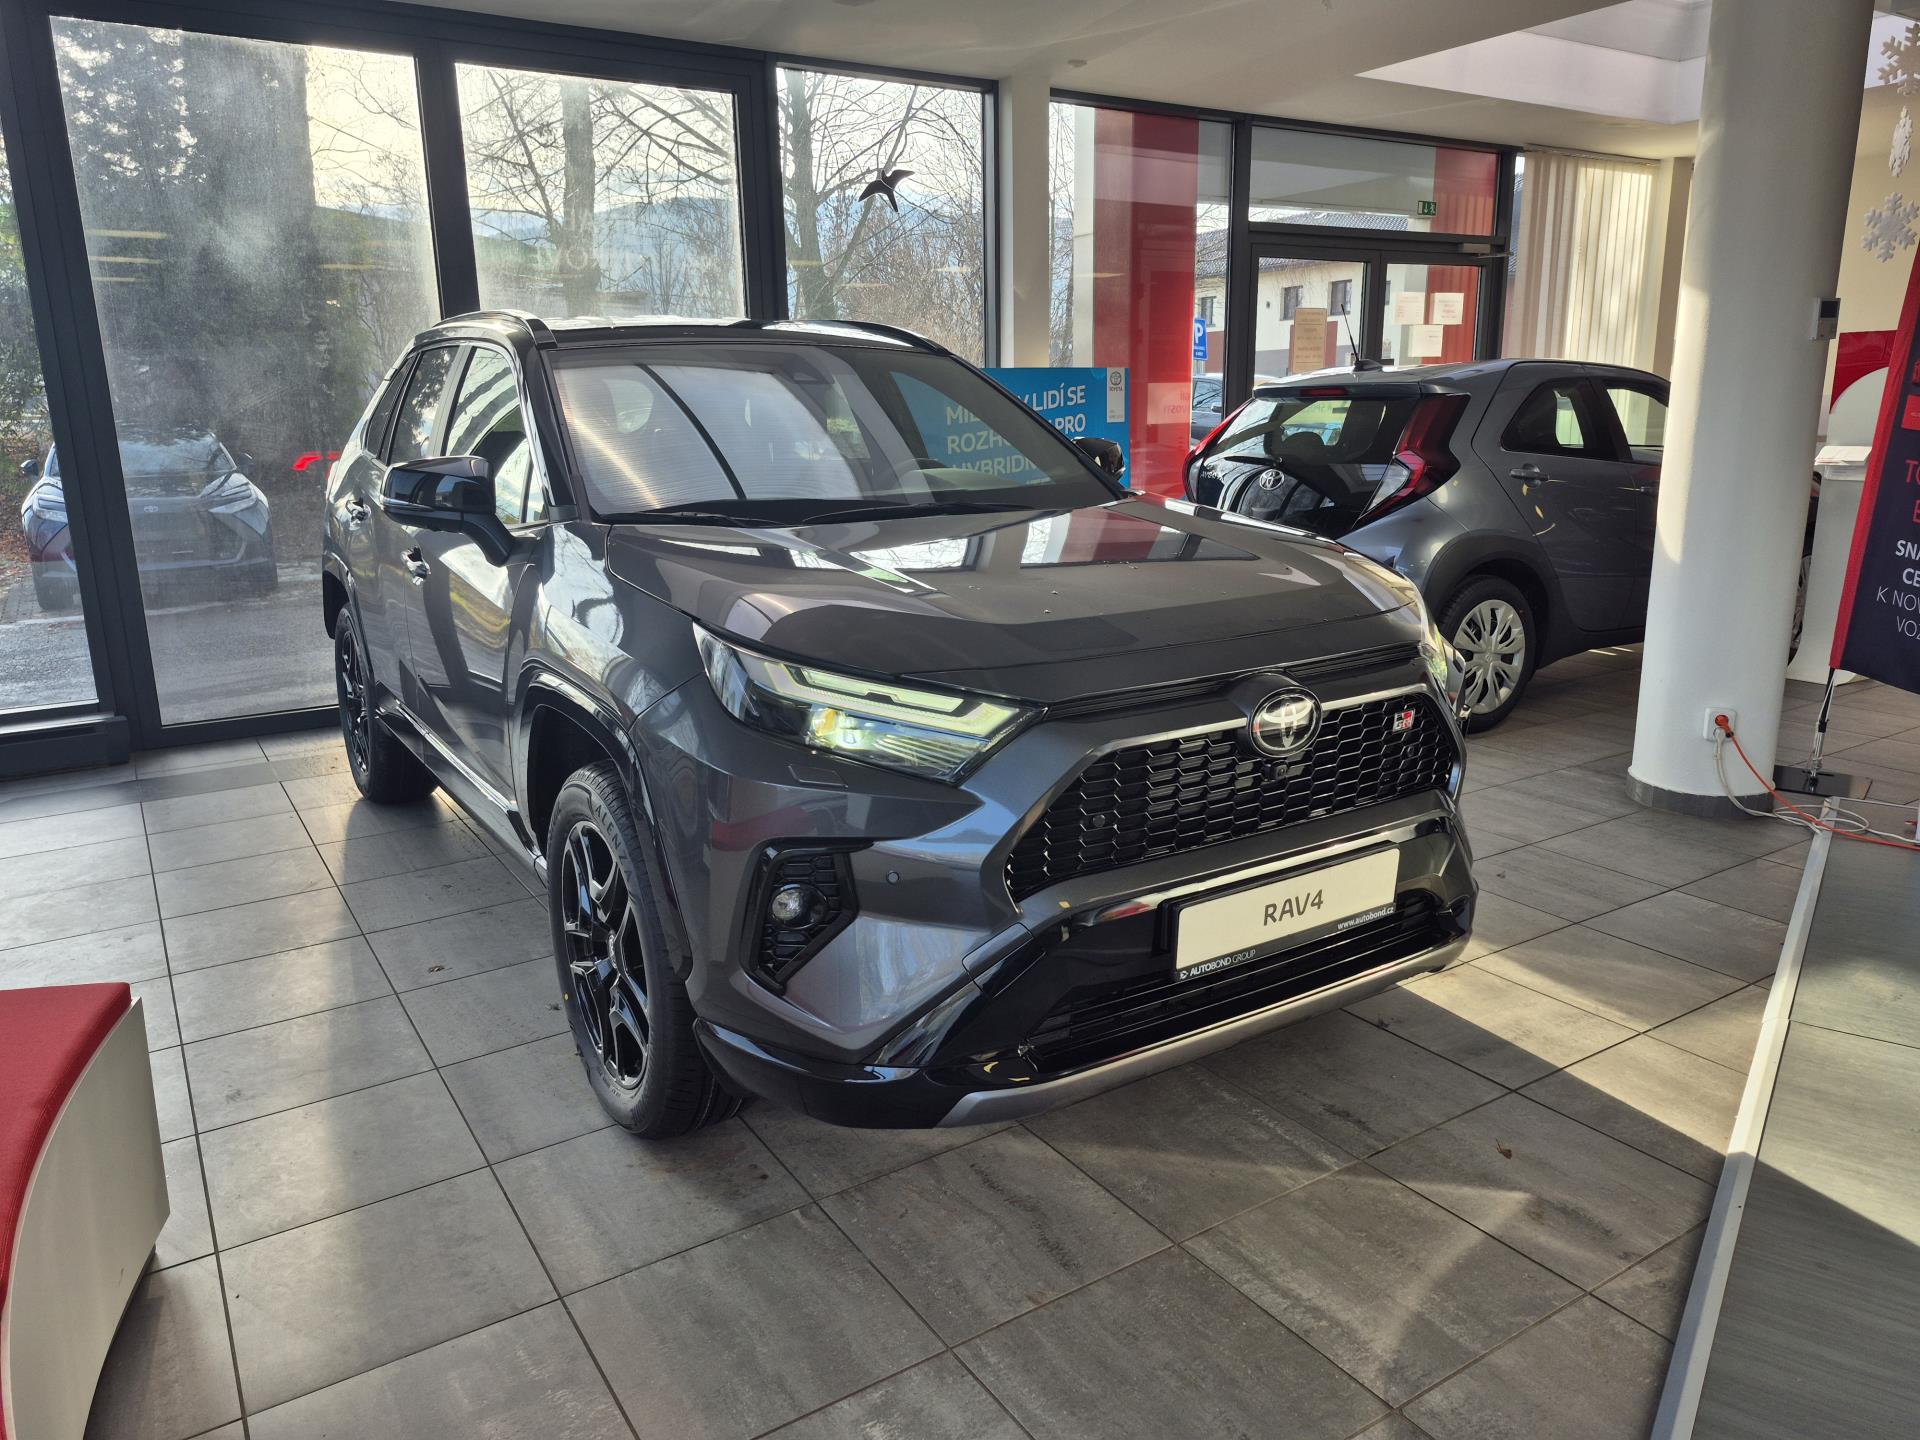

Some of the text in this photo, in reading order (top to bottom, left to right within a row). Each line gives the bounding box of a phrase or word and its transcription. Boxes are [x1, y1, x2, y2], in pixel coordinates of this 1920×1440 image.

[1032, 382, 1065, 411] LIDÍ
[1066, 385, 1087, 406] SE
[1054, 413, 1087, 434] PRO
[1876, 586, 1889, 603] K
[1263, 889, 1324, 926] RAV4
[1337, 906, 1395, 930] www.autobond.cz
[1189, 949, 1256, 977] AUTOBOND GROUP
